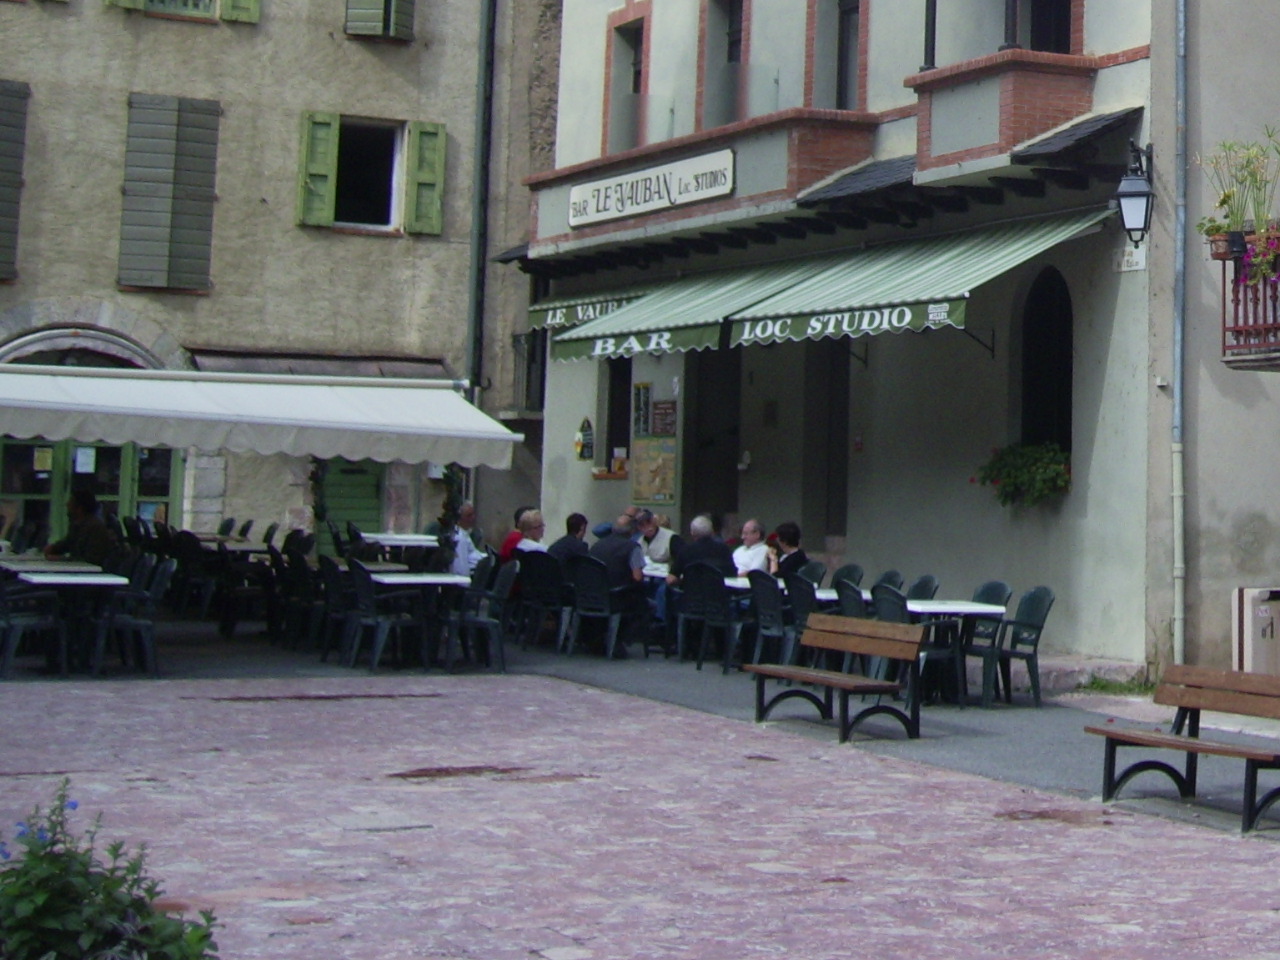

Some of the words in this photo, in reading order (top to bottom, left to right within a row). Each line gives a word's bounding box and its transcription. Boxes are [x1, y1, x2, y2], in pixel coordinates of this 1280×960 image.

[571, 200, 589, 218] BAR
[592, 186, 612, 213] LE
[614, 172, 677, 213] VAUBAN
[546, 308, 566, 324] LE
[576, 300, 628, 320] VAUB
[741, 318, 791, 340] LOC
[806, 306, 912, 335] STUDIO
[591, 331, 673, 356] BAR
